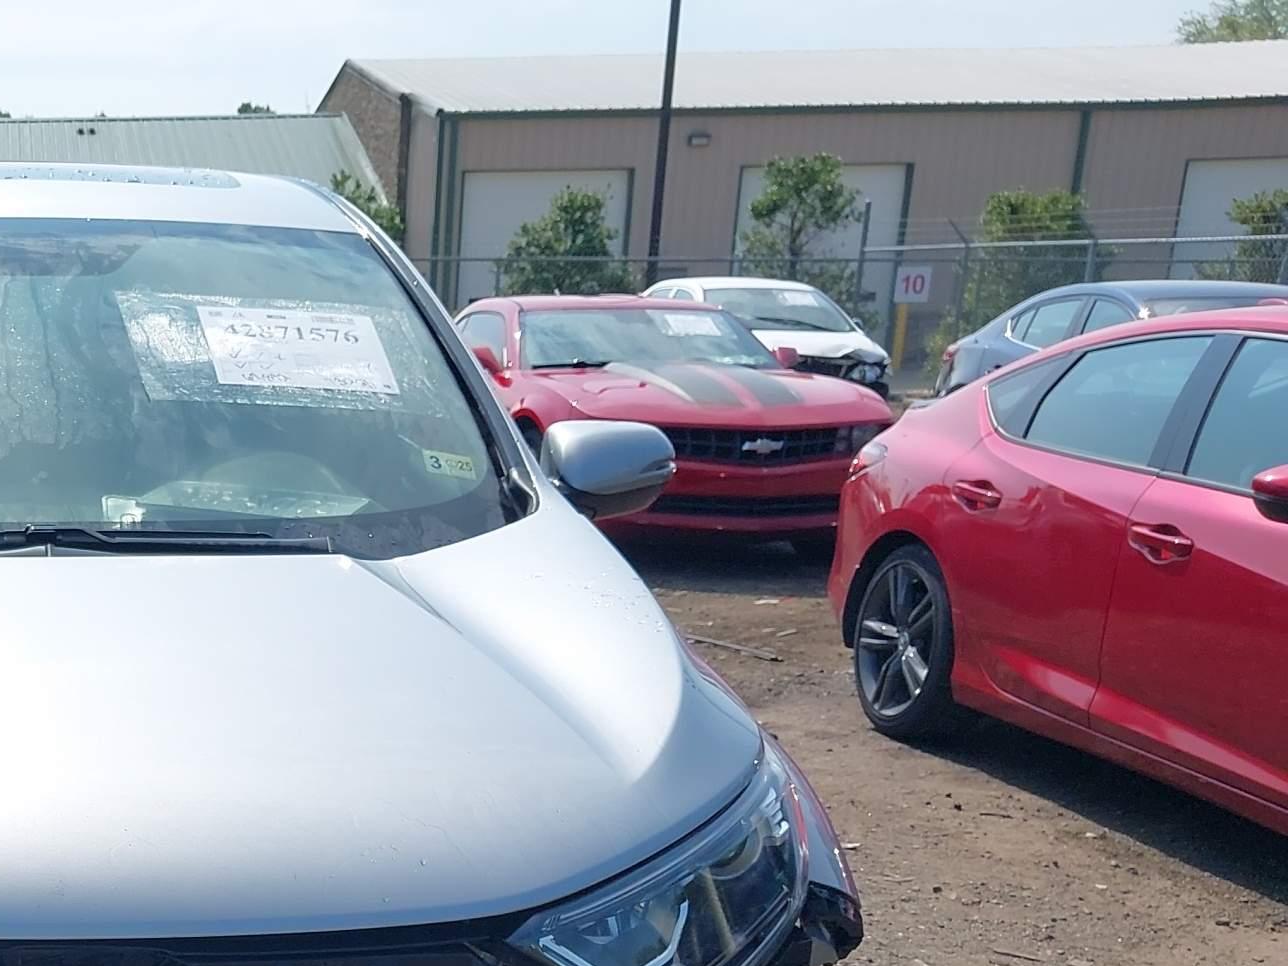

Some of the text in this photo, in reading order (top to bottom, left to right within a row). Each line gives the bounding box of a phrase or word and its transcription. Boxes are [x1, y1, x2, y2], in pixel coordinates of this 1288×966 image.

[903, 273, 925, 296] 10
[224, 323, 360, 344] 42871576
[429, 455, 442, 470] 3
